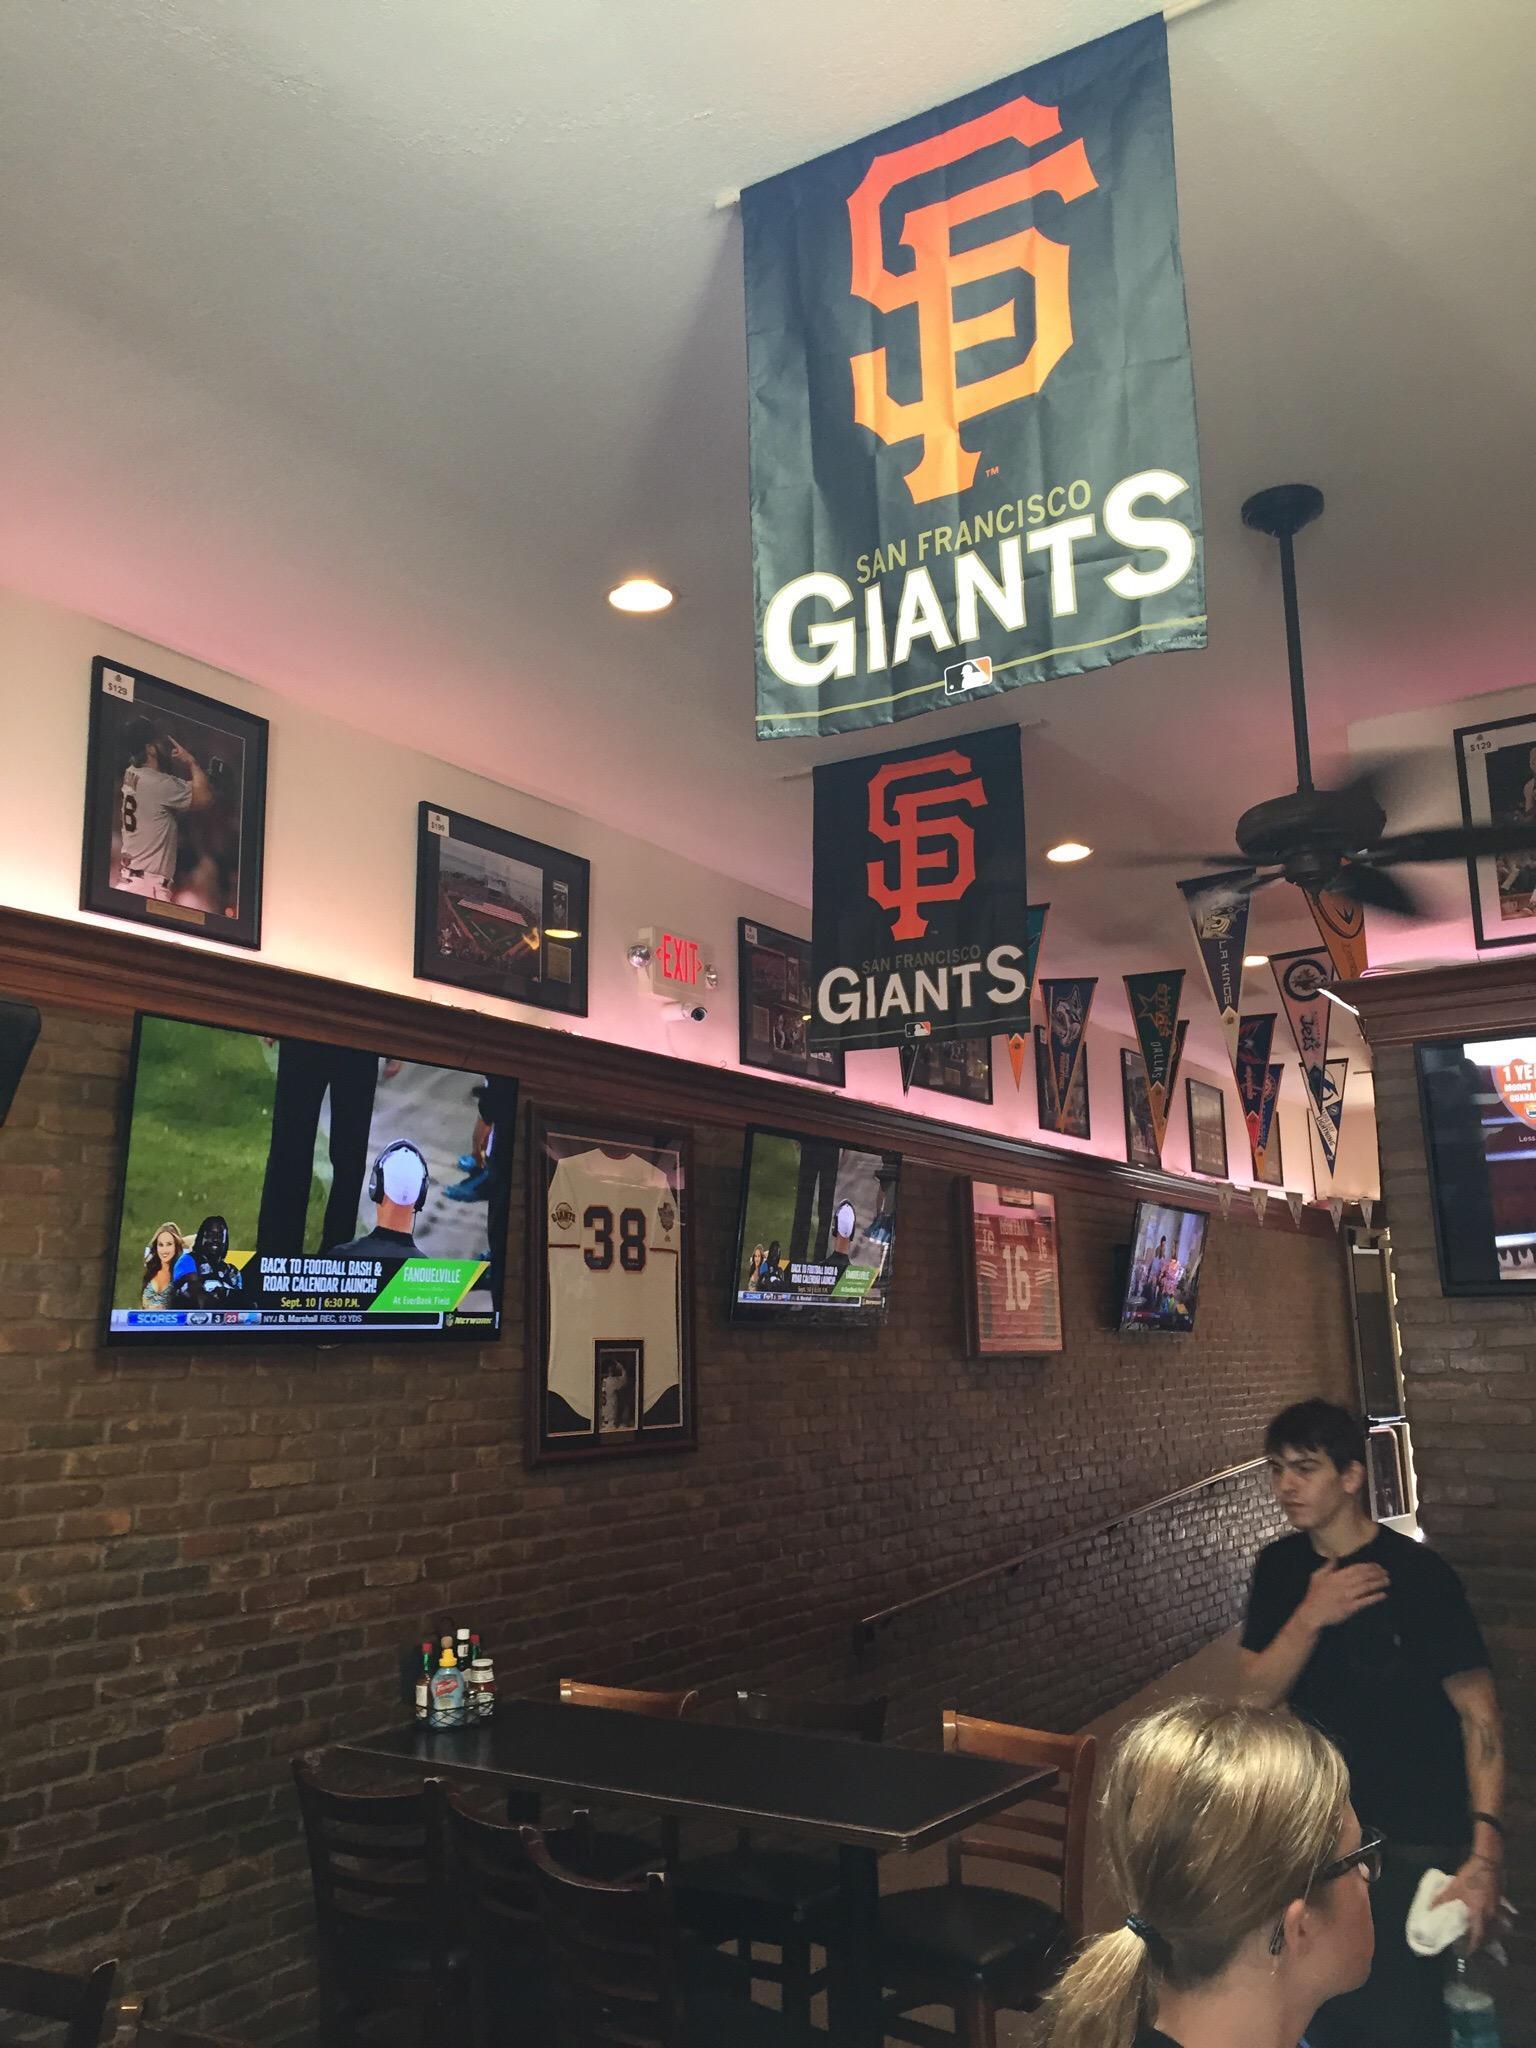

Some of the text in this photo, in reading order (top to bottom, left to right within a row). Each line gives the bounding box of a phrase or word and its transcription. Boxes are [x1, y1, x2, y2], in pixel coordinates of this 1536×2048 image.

[856, 479, 1092, 584] SAN FRANCISCO
[763, 468, 1196, 687] GIANTS
[107, 683, 129, 696] $129
[663, 934, 698, 985] EXIT
[861, 944, 982, 975] SAN FRANCISCO
[1218, 940, 1233, 1005] LA KINGS
[817, 944, 1027, 1025] GIANTS
[1150, 1041, 1162, 1078] DALLAS
[1503, 1063, 1536, 1082] 1 YE
[583, 1204, 647, 1272] 38
[260, 1257, 383, 1277] BACK TO FOOTBALL BASH &
[262, 1275, 378, 1293] ROAR CALENDAR LAUNCH!
[1002, 1244, 1031, 1312] 16
[137, 1313, 178, 1324] SCORES
[214, 1314, 221, 1324] 3
[226, 1314, 237, 1324] 23
[319, 1314, 337, 1324] REC,
[338, 1315, 348, 1323] 12
[348, 1315, 363, 1323] YDS
[280, 1297, 361, 1309] Sept. 10 6:30 P.M.
